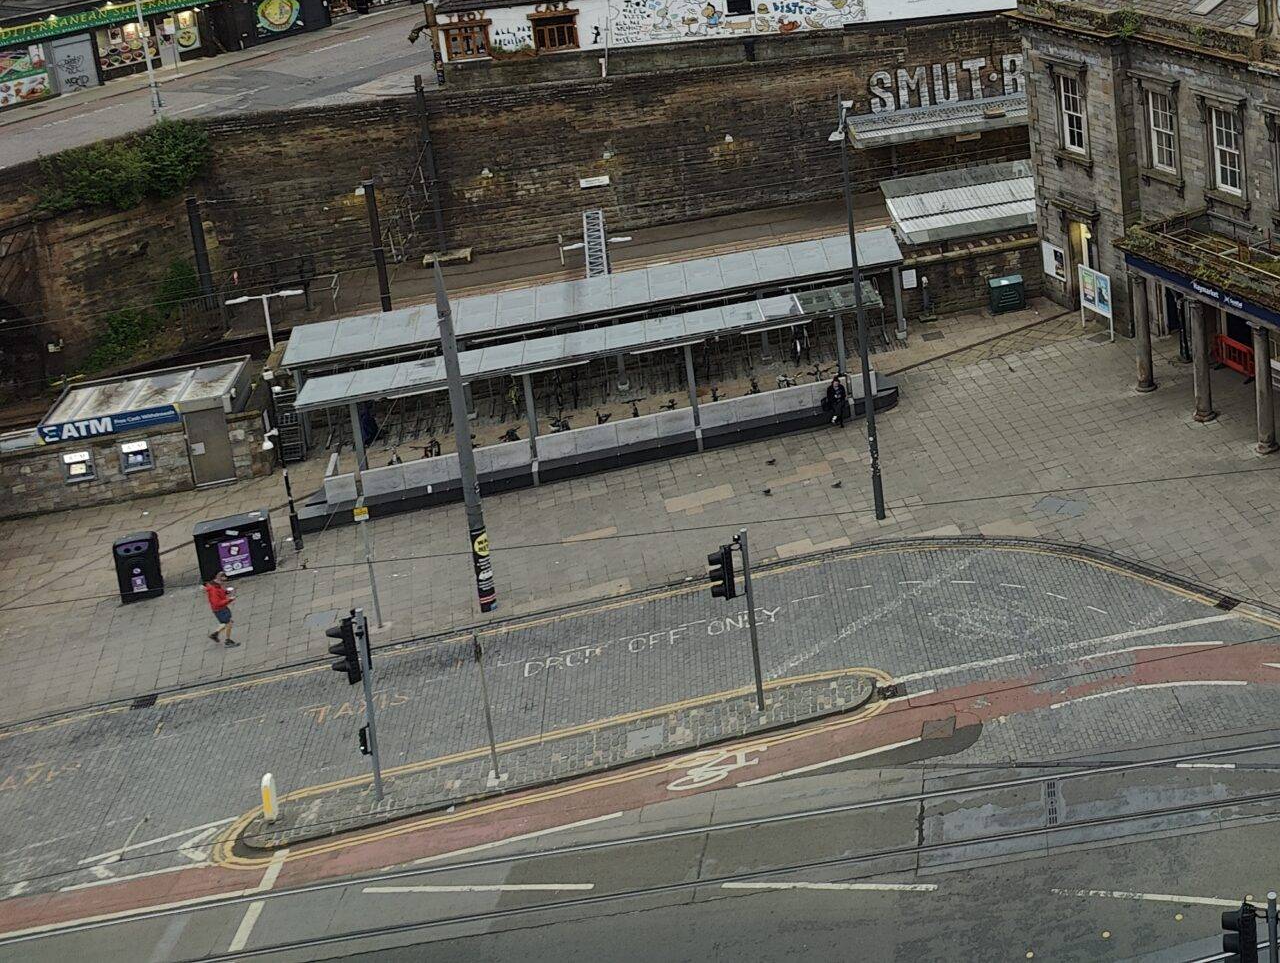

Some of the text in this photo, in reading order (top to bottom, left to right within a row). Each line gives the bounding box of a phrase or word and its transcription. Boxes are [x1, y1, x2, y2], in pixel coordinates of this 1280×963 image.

[0, 9, 107, 38] DITERRANEAN
[61, 416, 114, 440] ATM
[628, 627, 689, 653] OFF
[707, 606, 780, 636] ONLY
